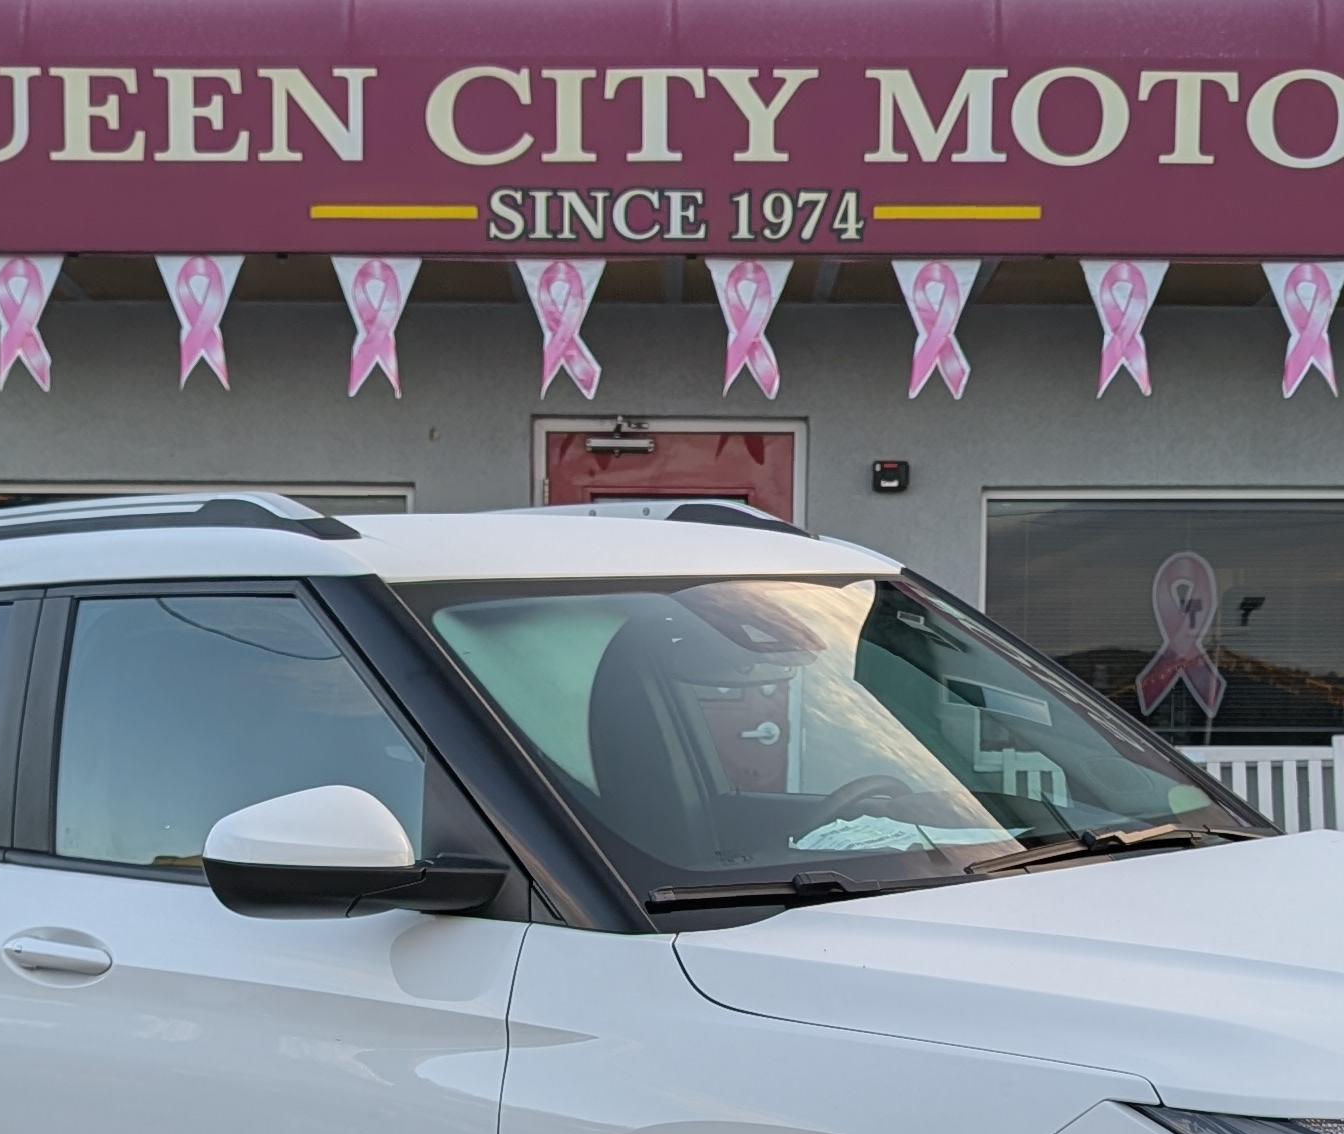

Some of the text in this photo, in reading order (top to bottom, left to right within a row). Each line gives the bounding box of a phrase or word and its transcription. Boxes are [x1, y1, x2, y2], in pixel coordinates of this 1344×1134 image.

[424, 65, 820, 166] CITY
[487, 187, 865, 242] SINCE 1974
